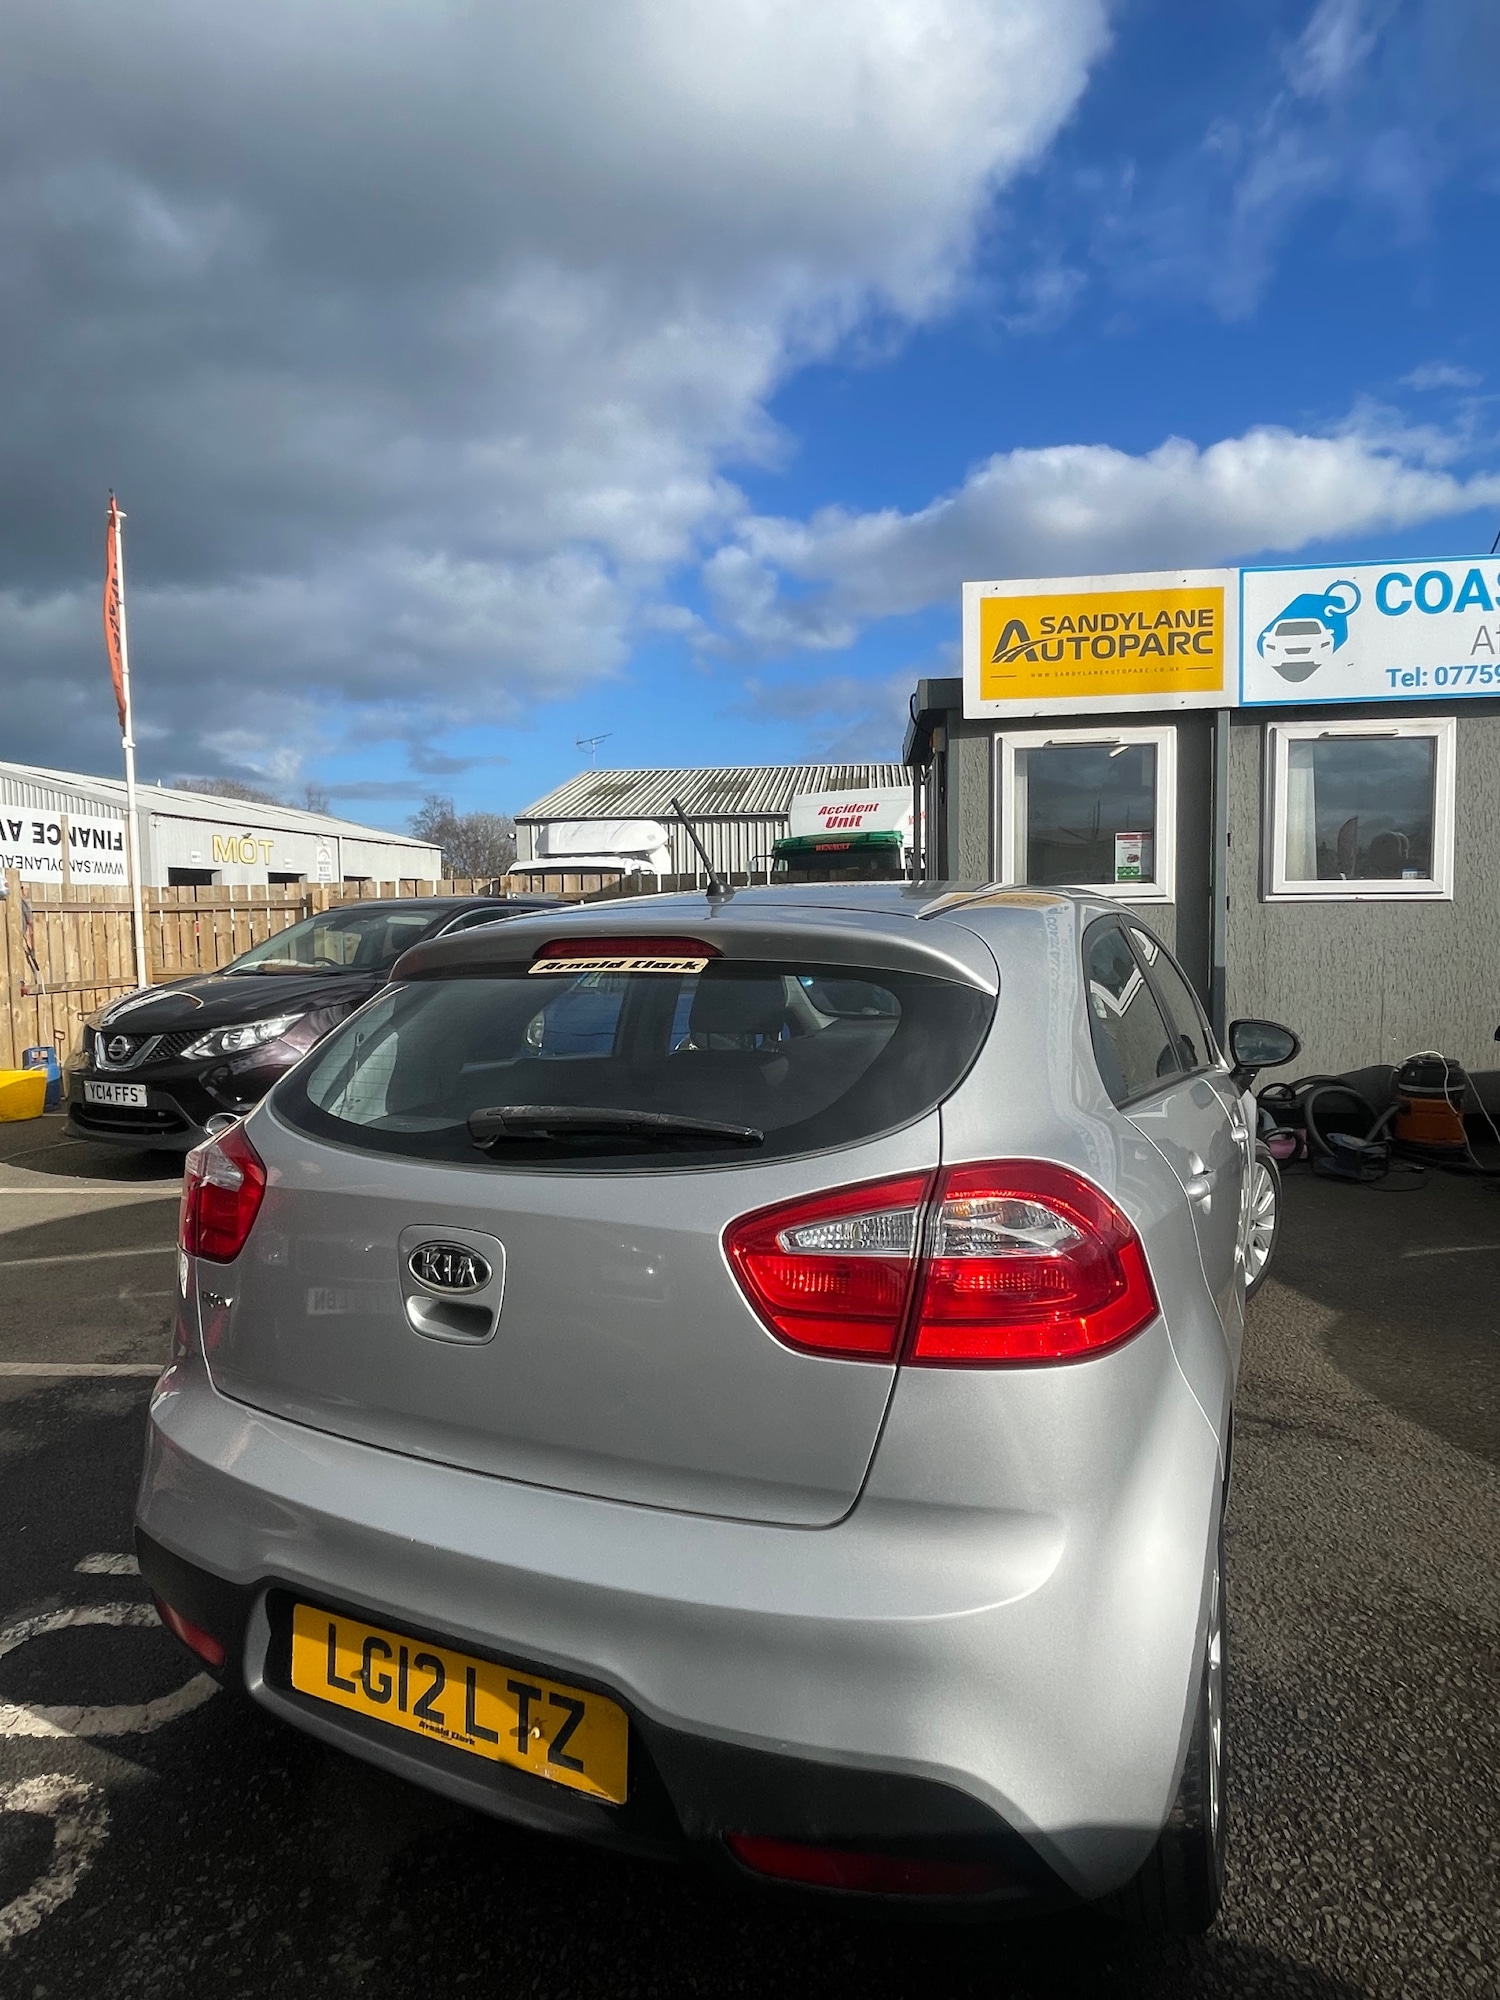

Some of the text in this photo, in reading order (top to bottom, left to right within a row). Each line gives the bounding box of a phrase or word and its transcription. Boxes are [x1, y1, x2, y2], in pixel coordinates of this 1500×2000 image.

[1375, 568, 1500, 616] COA
[1040, 608, 1214, 635] SANDYLANE
[991, 619, 1214, 663] AUTOPARC
[1385, 666, 1428, 688] Tel:
[818, 803, 879, 816] Accident
[826, 815, 863, 829] Unit
[32, 821, 123, 851] FINANCE
[212, 834, 274, 866] MOT
[537, 960, 700, 971] Arnold Clark
[90, 1084, 138, 1103] YC14 FFS
[422, 1248, 479, 1285] KIA
[327, 1623, 585, 1774] LG12 LTZ
[418, 1720, 450, 1737] Arnold
